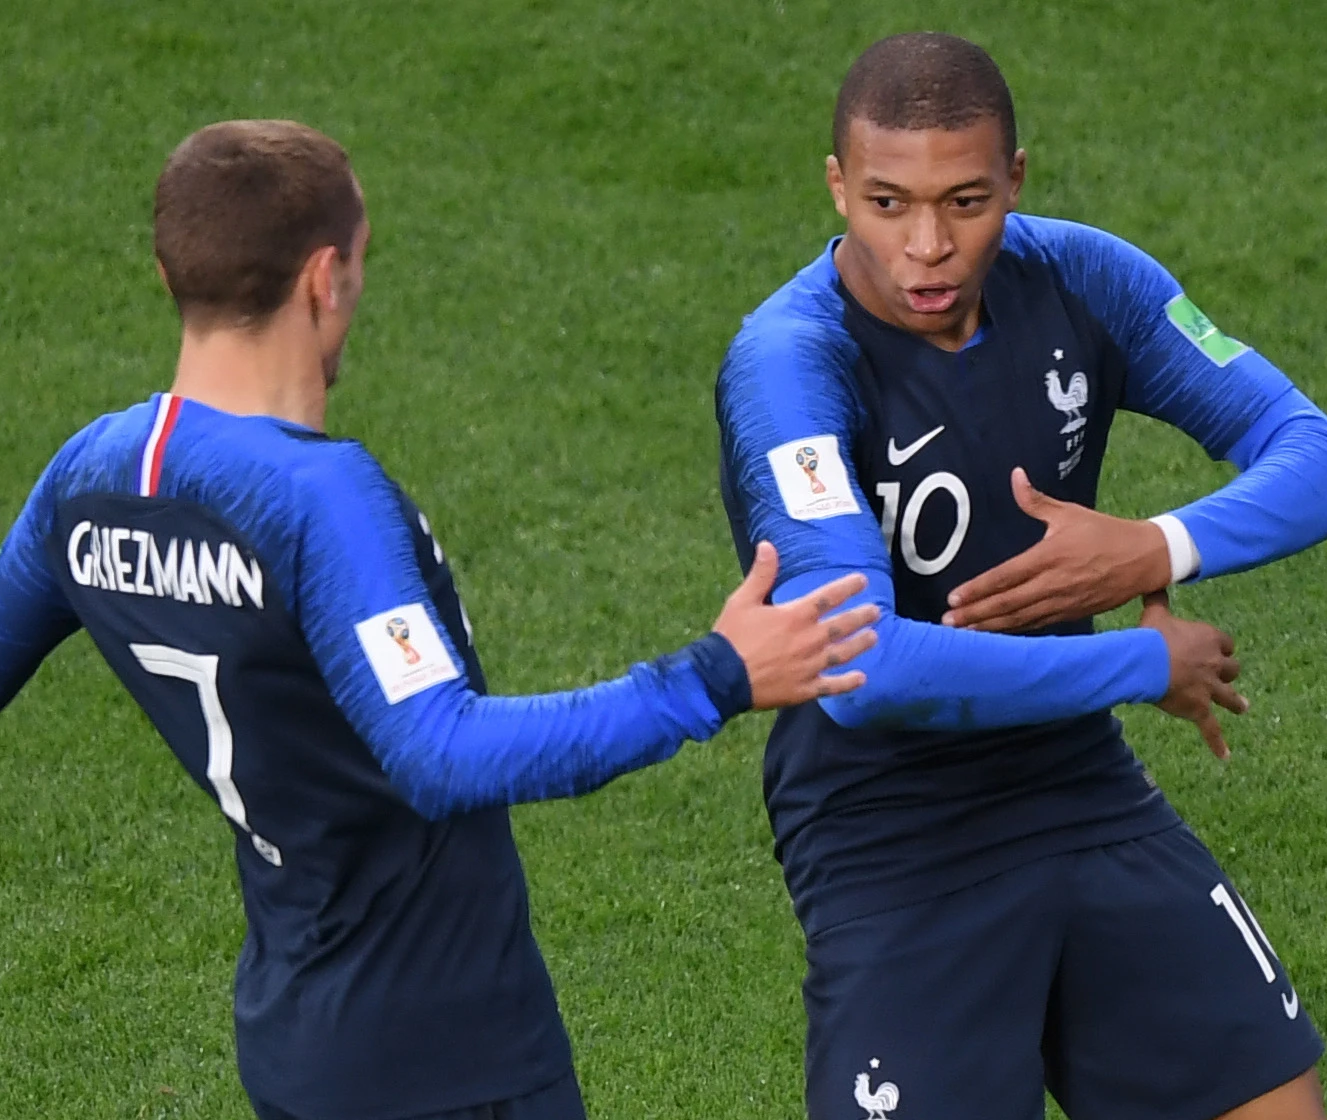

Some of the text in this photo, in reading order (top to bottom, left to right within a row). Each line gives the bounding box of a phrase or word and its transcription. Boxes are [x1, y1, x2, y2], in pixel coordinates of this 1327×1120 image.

[876, 471, 971, 576] 10
[129, 643, 283, 867] 7
[1210, 883, 1280, 984] 1
